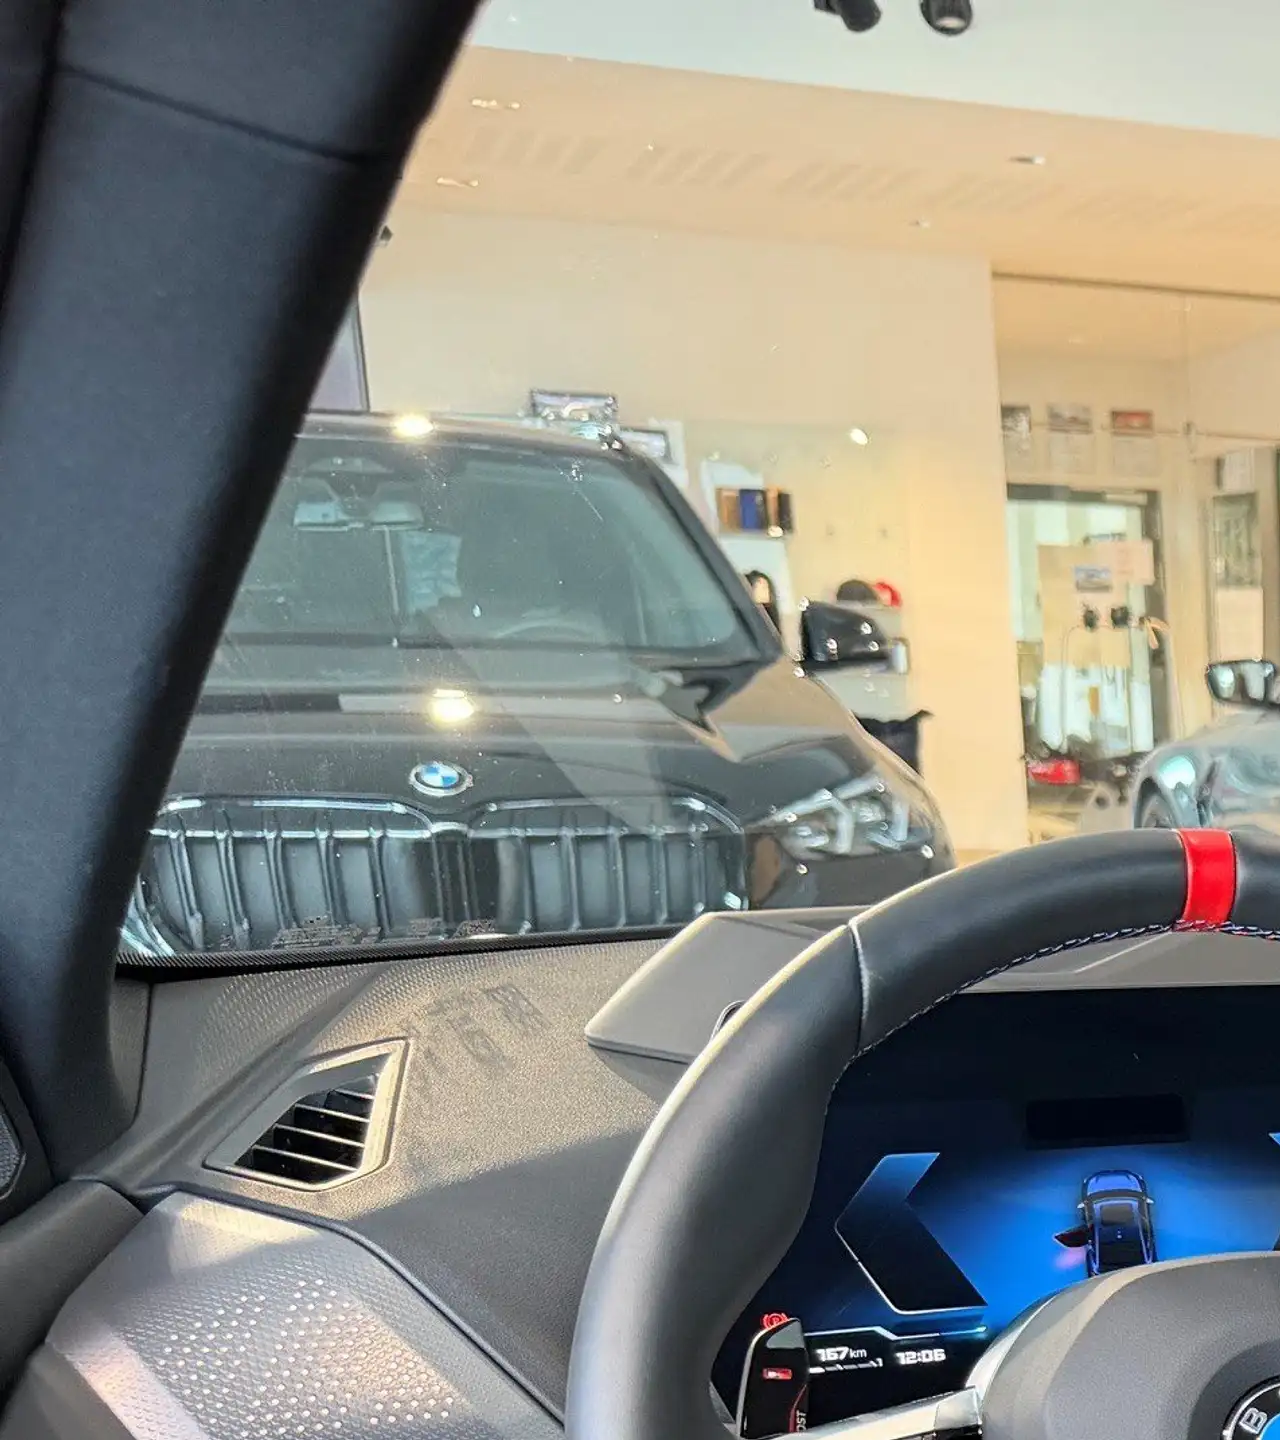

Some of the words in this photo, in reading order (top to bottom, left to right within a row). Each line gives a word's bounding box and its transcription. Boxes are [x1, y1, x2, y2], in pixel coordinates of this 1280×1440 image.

[816, 1346, 849, 1361] 167
[849, 1347, 867, 1359] km
[896, 1348, 946, 1365] 12:06
